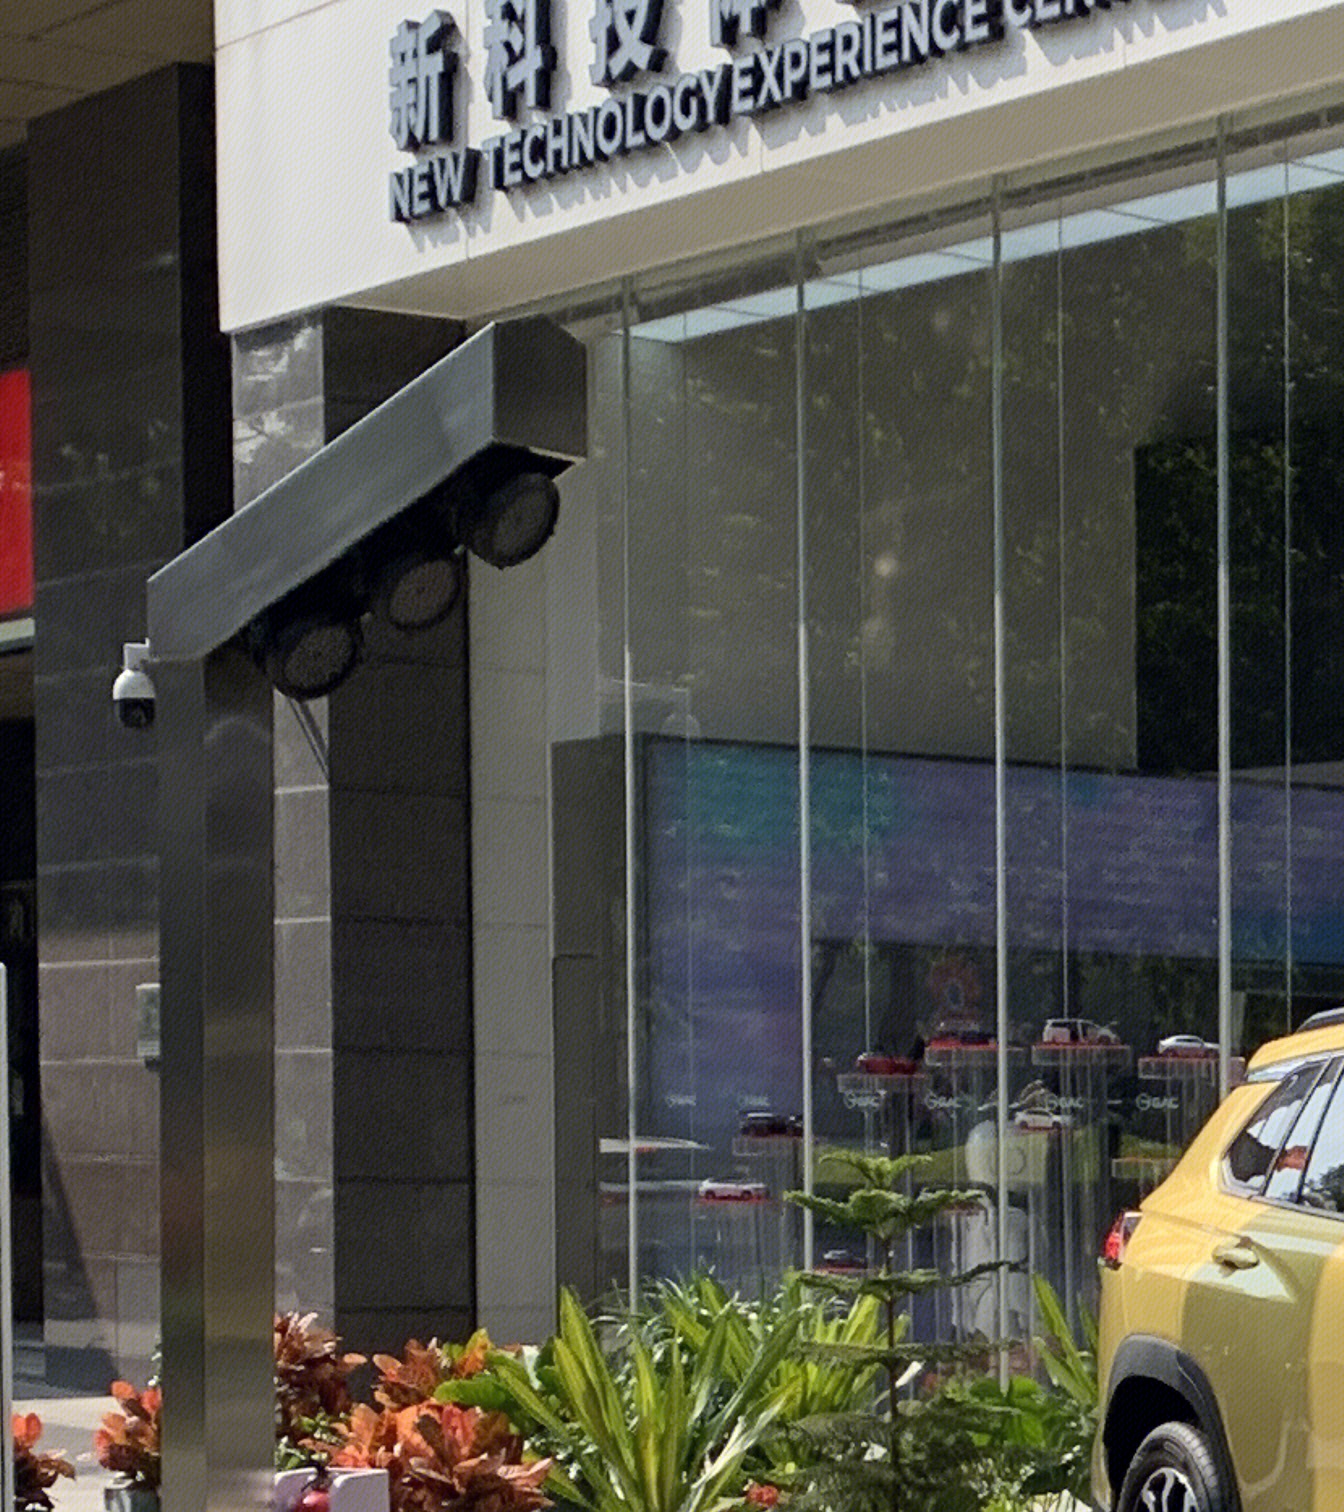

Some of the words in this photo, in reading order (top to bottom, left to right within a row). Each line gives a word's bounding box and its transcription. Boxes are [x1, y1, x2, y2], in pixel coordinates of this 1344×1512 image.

[389, 149, 474, 223] NEW
[482, 64, 729, 190] TECHNOLOGY
[731, 0, 992, 117] EXPERIENCE
